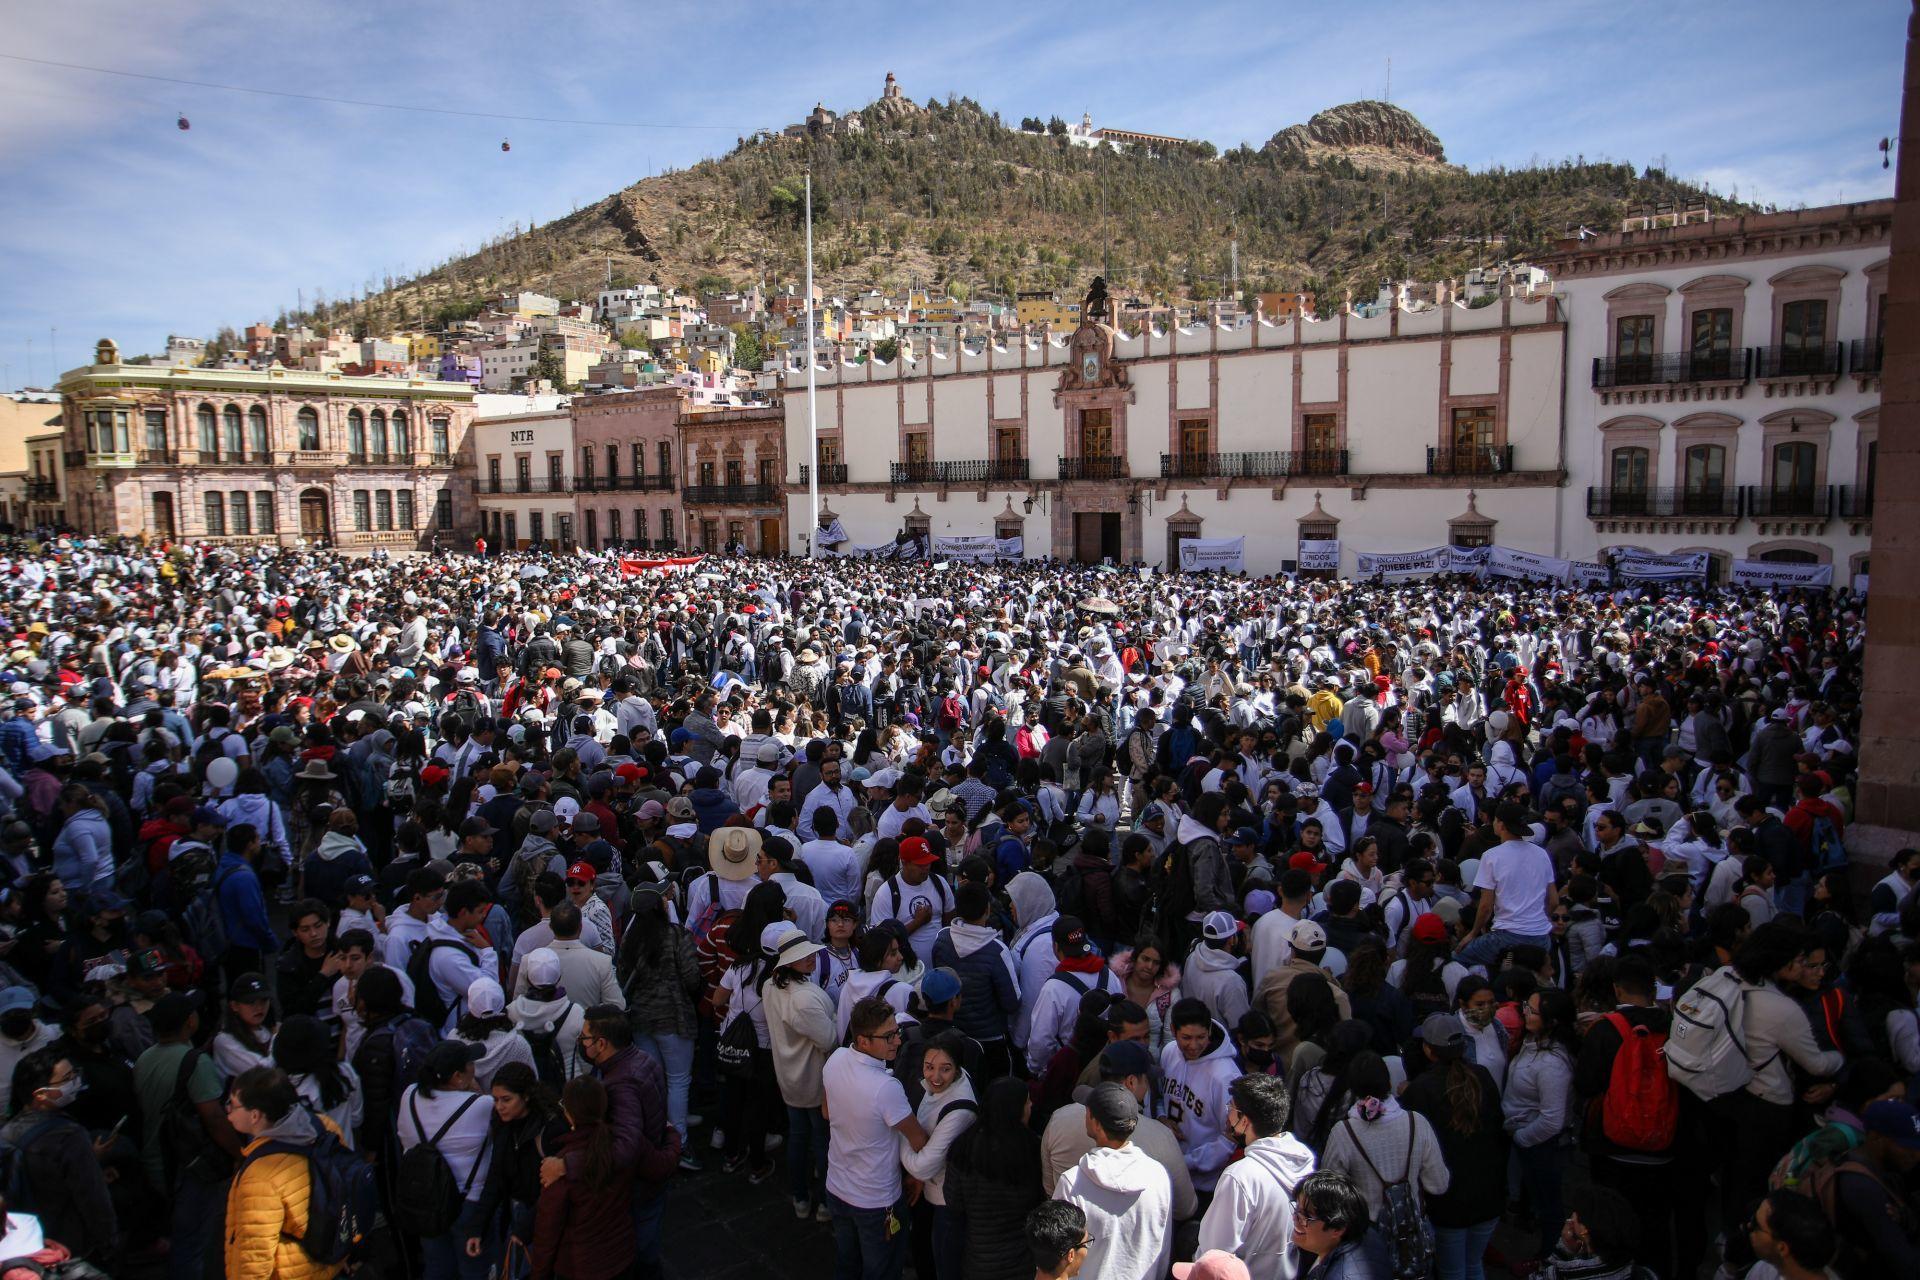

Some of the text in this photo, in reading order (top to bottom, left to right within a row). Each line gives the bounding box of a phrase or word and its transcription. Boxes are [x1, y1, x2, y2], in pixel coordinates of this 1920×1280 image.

[510, 430, 534, 442] NTR
[941, 543, 962, 551] Consejo
[1473, 552, 1490, 561] UAZ
[1375, 560, 1434, 573] ¡QUIERE PAZ!
[1575, 561, 1607, 571] ZACATEC
[1582, 570, 1606, 578] QUIERE
[1735, 570, 1813, 582] TODOS SOMOS UAZ
